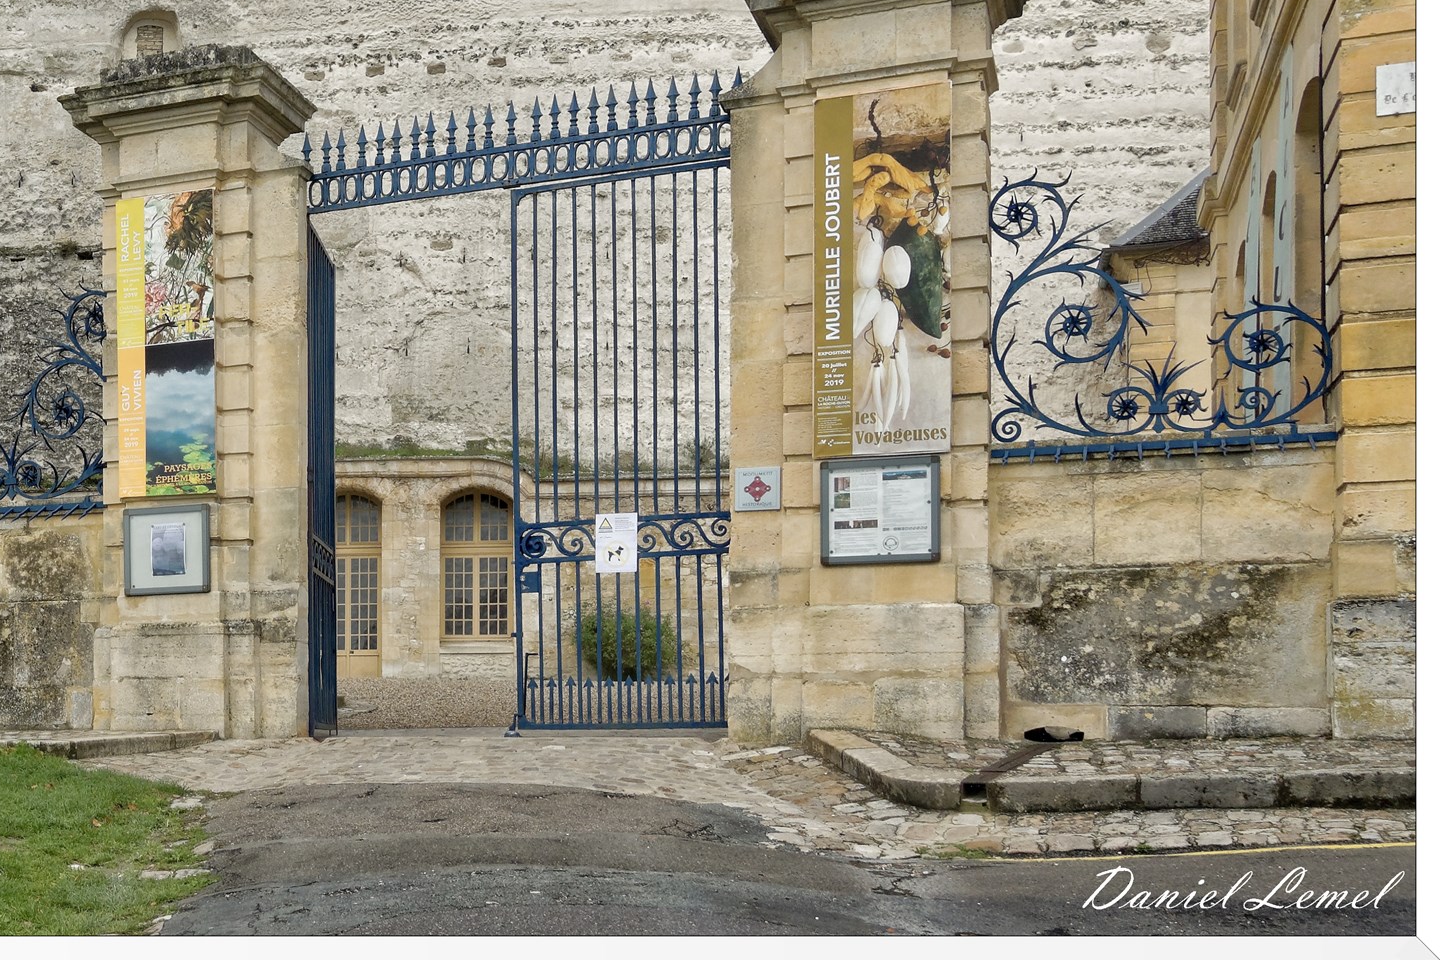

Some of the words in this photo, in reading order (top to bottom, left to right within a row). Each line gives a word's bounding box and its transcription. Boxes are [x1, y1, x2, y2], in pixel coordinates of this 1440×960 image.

[825, 153, 841, 242] JOUBERT
[120, 213, 129, 262] RACHEL
[133, 231, 141, 260] LEVY
[825, 246, 841, 340] MURIELLE
[133, 369, 142, 411] VIVIEN
[824, 379, 844, 387] 2019
[121, 385, 130, 411] GUY
[855, 411, 876, 424] les
[163, 462, 212, 473] PAYSAGES
